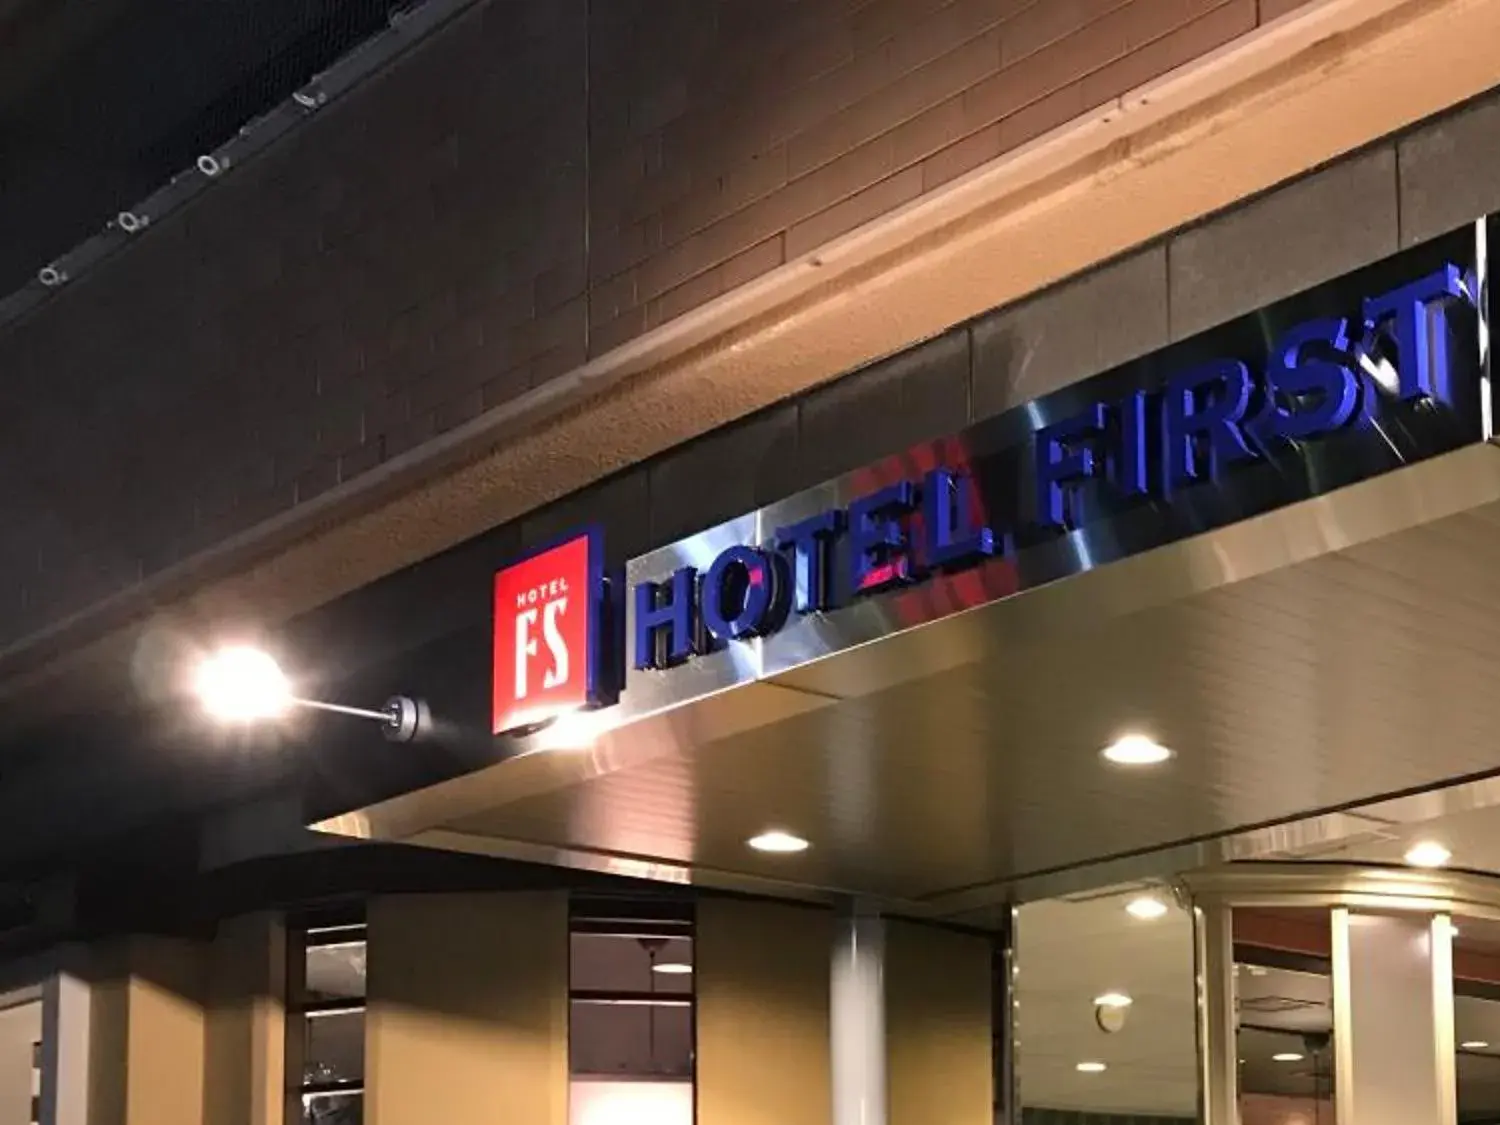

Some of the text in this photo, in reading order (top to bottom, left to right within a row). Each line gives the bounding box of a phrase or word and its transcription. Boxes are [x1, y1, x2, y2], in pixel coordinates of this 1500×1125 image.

[634, 468, 994, 670] HOTEL
[1034, 262, 1466, 526] FIRST
[517, 576, 569, 609] HOTEL
[514, 597, 570, 700] FS
